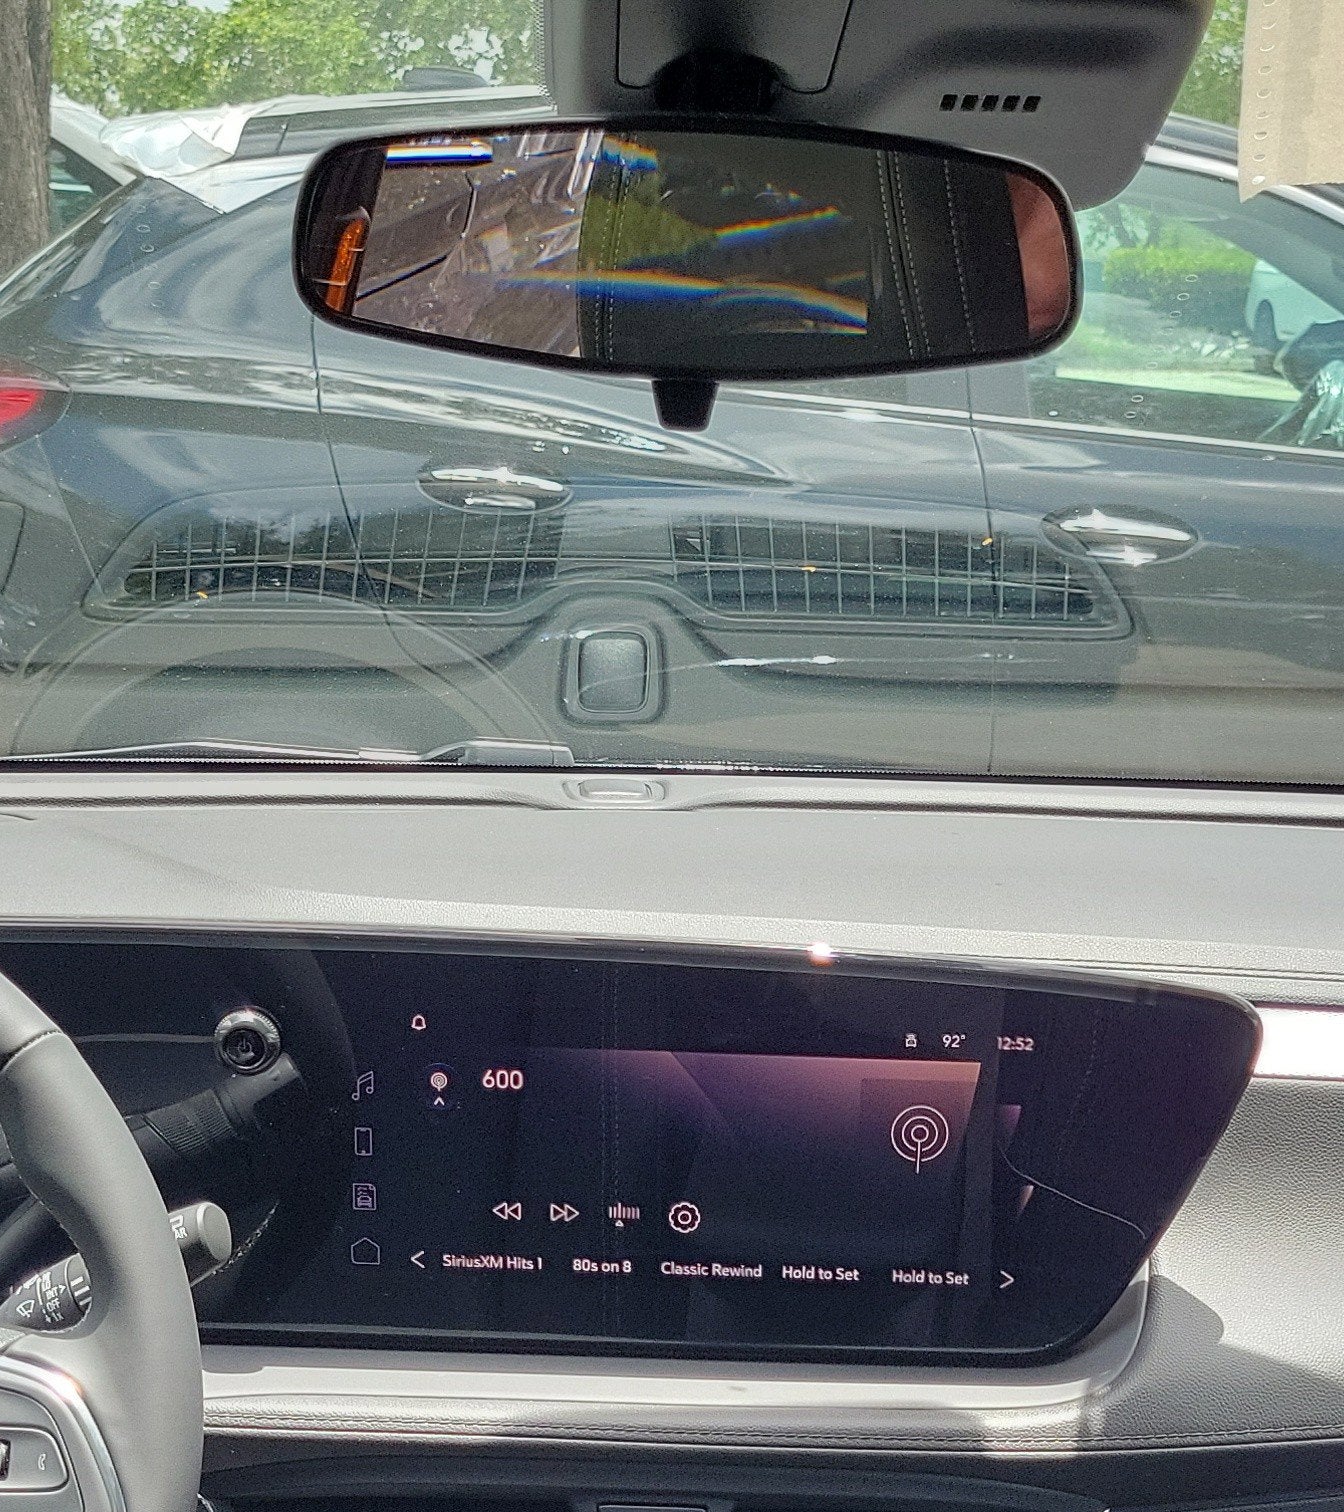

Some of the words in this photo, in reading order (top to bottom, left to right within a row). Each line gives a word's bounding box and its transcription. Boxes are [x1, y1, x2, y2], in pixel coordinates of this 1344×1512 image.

[942, 1034, 966, 1048] 92°
[997, 1036, 1035, 1051] 12:52
[482, 1069, 524, 1090] 600
[442, 1254, 503, 1270] SiriusXM
[506, 1257, 534, 1270] Hits
[572, 1258, 598, 1273] 80s
[602, 1262, 619, 1273] on
[622, 1259, 632, 1273] 8
[660, 1261, 709, 1277] Classic
[711, 1263, 762, 1279] Rewind
[782, 1265, 815, 1280] Hold
[818, 1267, 833, 1281] to
[835, 1267, 860, 1282] Set
[892, 1269, 925, 1284] Hold
[928, 1271, 943, 1285] to
[945, 1271, 969, 1286] Set
[47, 1298, 61, 1311] OFF
